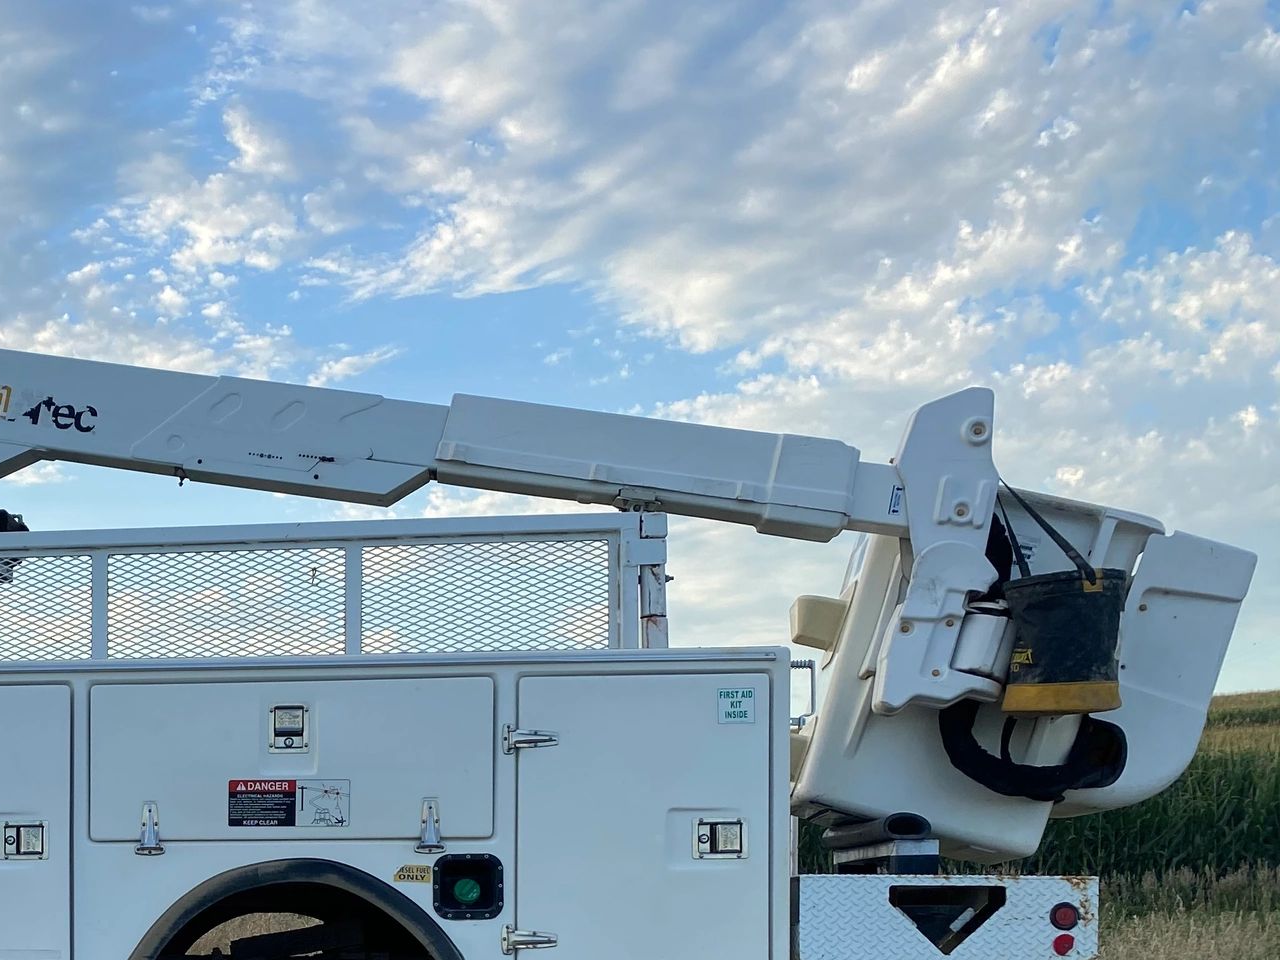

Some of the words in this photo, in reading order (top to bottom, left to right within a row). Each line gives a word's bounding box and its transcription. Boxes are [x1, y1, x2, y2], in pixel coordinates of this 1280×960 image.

[720, 690, 739, 699] FIRST
[741, 690, 753, 699] AID
[730, 700, 742, 709] KIT
[724, 710, 748, 719] INSIDE
[247, 782, 289, 791] DANGER
[398, 873, 426, 881] ONLY
